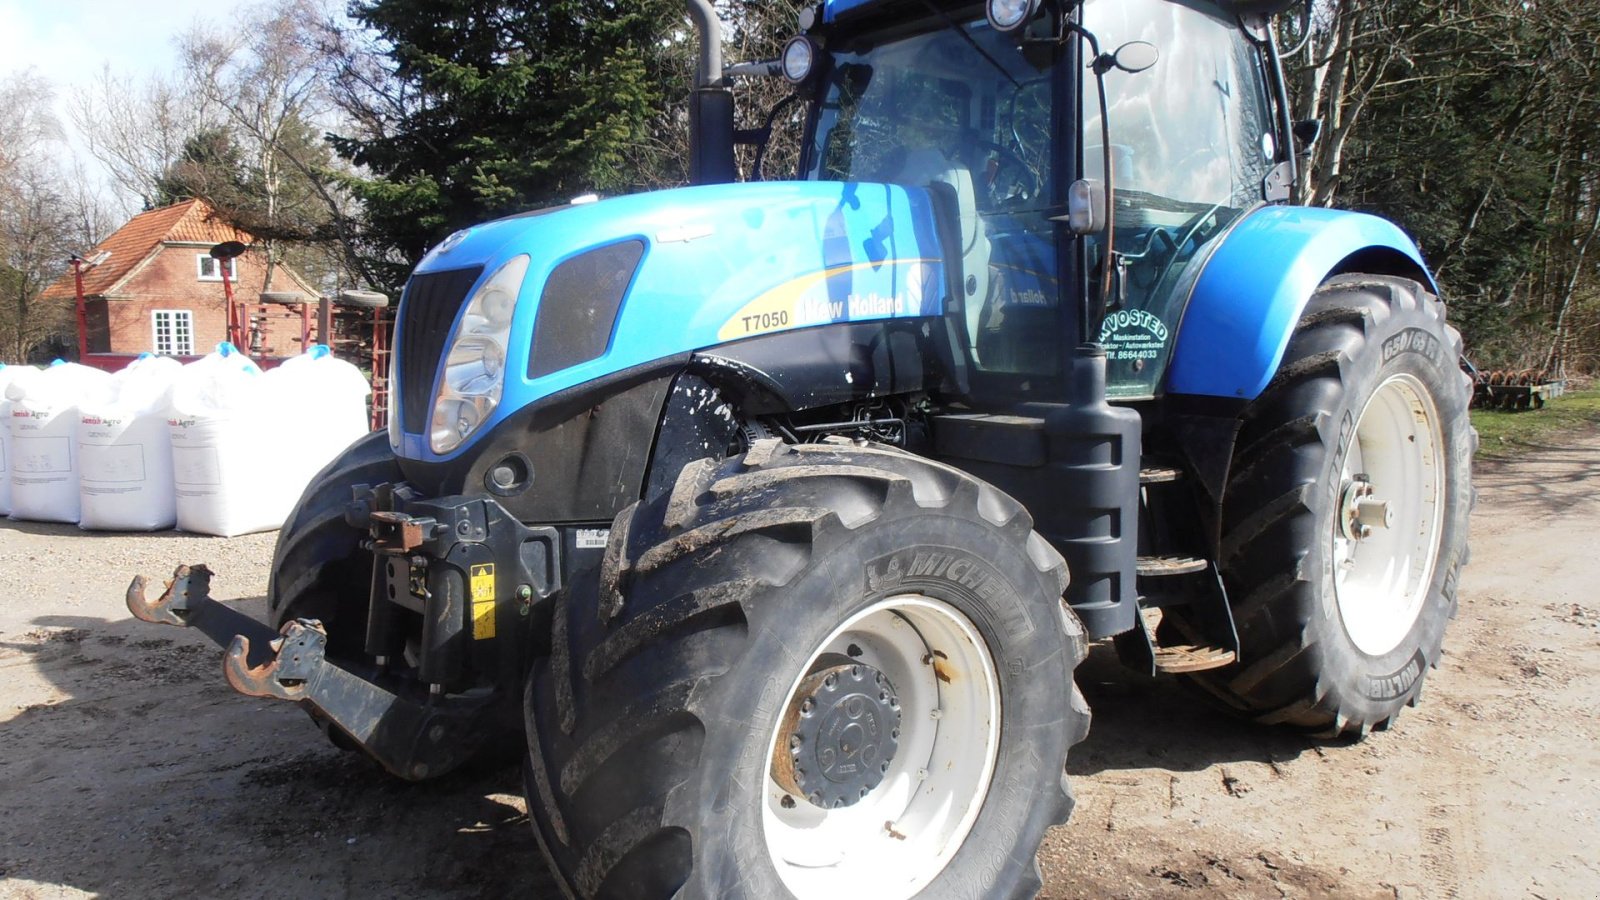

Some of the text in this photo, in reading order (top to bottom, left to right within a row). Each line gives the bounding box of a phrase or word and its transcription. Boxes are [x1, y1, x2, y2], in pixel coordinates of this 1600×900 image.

[848, 292, 903, 317] Holland
[742, 310, 788, 332] T7050
[907, 552, 1034, 639] MICHELIN
